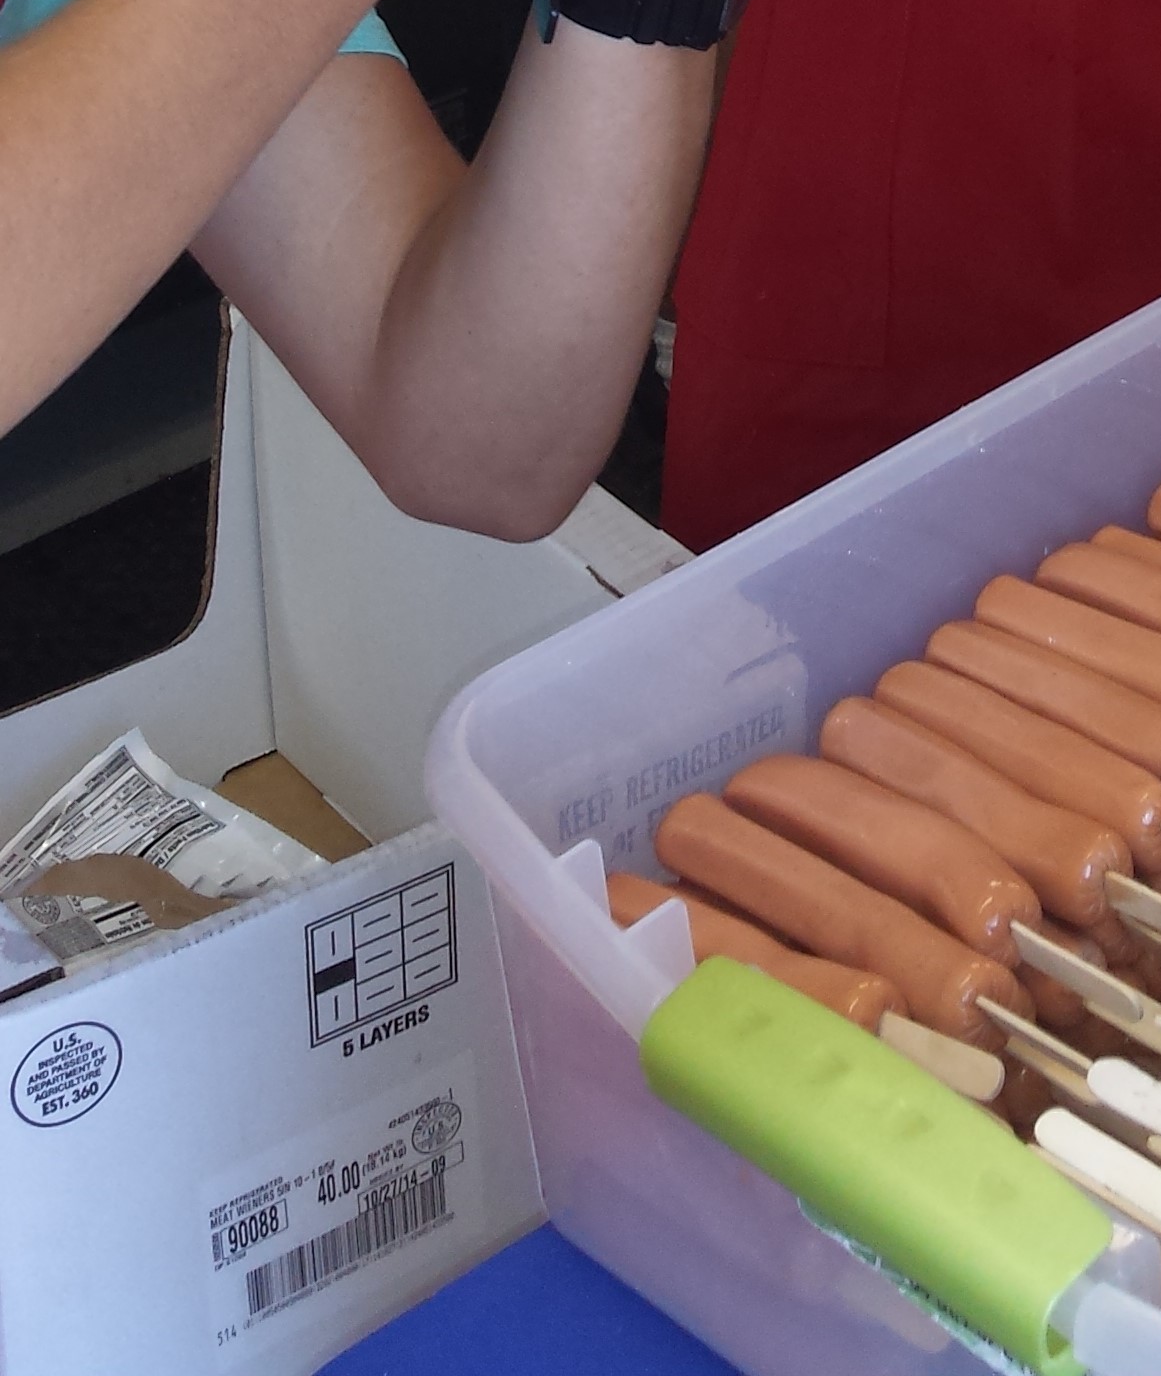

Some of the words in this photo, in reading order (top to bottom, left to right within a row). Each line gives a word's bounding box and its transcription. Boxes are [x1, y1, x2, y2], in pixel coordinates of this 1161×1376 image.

[53, 1032, 82, 1053] U.S.
[343, 1039, 354, 1057] 5
[360, 1004, 430, 1051] LAYERS
[26, 1061, 92, 1096] DEPARTMENT
[93, 1054, 108, 1067] OF
[28, 1069, 49, 1085] AND
[51, 1053, 89, 1076] PASSED
[91, 1045, 105, 1059] BY
[37, 1041, 94, 1071] INSPECTED
[33, 1068, 102, 1103] AGRICULTURE
[42, 1094, 69, 1117] EST.
[71, 1081, 100, 1104] 360
[318, 1160, 361, 1206] 40.00
[210, 1209, 233, 1230] MEAT
[236, 1189, 275, 1217] WIENERS
[228, 1205, 280, 1254] 90088
